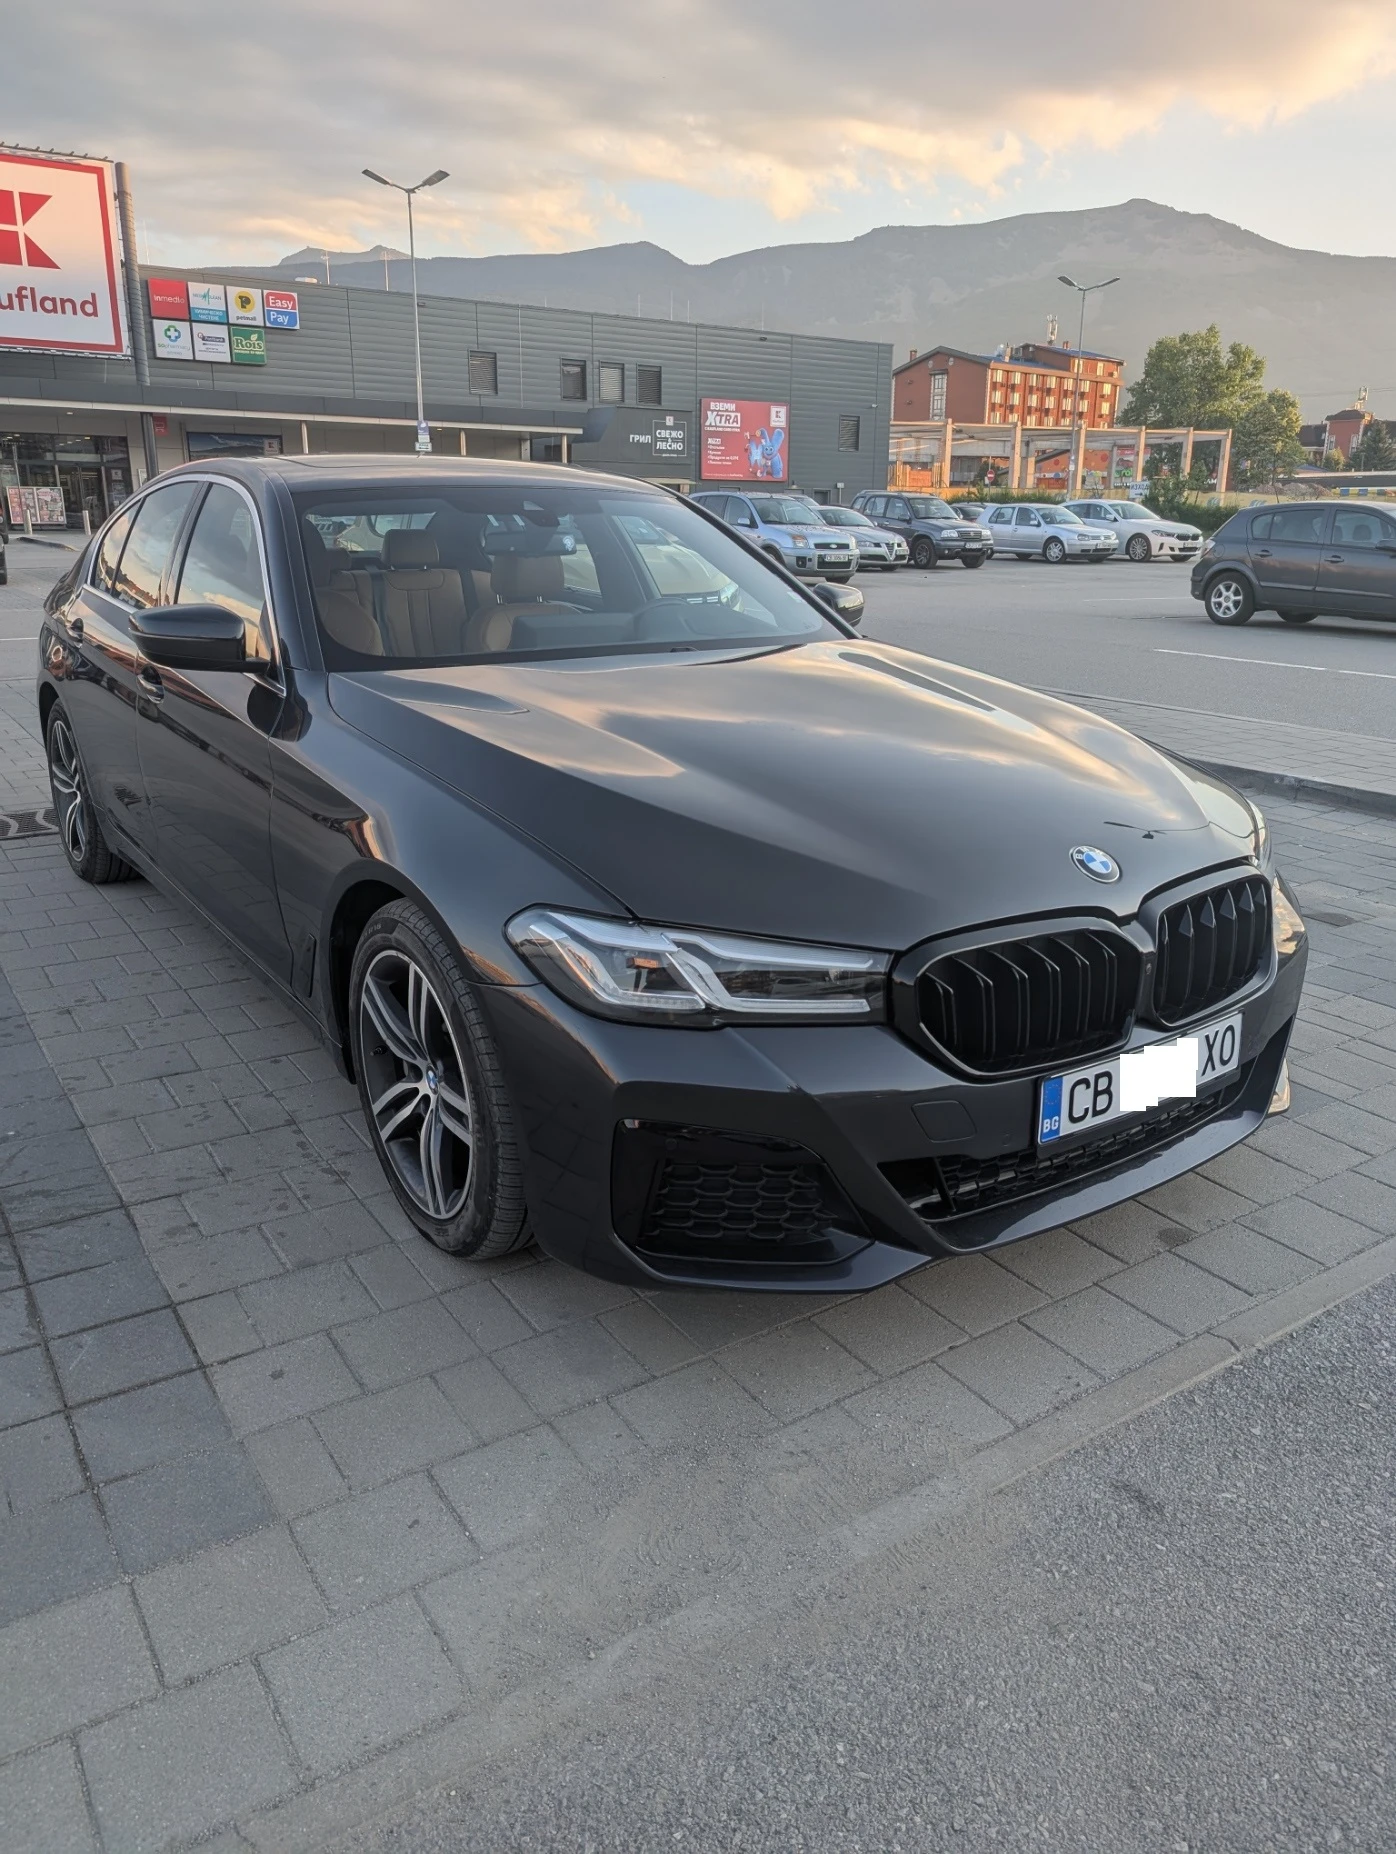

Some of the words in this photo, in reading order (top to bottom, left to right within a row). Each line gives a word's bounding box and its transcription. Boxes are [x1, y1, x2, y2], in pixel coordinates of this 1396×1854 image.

[268, 296, 294, 310] Easy
[270, 311, 289, 325] Pay
[233, 336, 264, 351] Rois
[710, 401, 736, 411] ВЗЕМИ
[704, 410, 740, 427] XTRA
[629, 434, 652, 443] ГРИЛ
[656, 429, 684, 439] СВЕЖО
[656, 441, 684, 450] ЛЕСНО
[1130, 483, 1149, 491] ИЗХОД
[1068, 1070, 1114, 1124] CB
[1201, 1024, 1236, 1077] XO
[1043, 1115, 1060, 1132] BG
